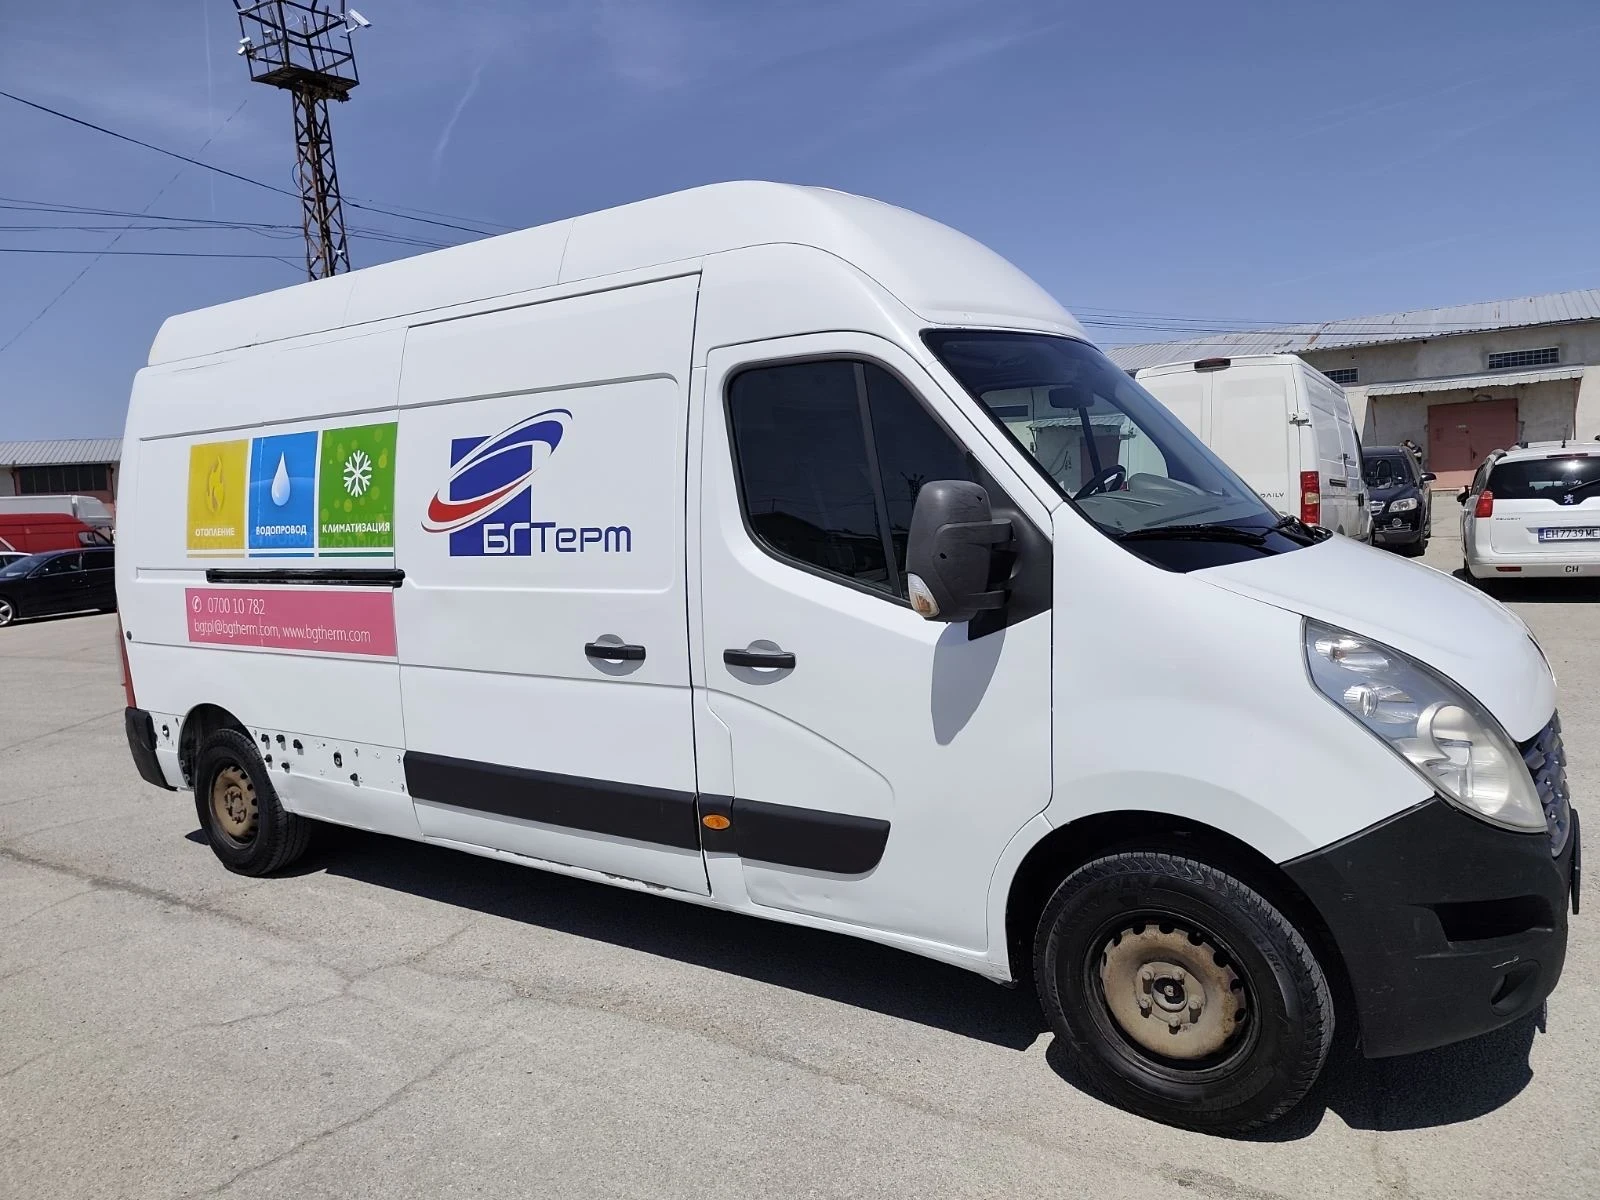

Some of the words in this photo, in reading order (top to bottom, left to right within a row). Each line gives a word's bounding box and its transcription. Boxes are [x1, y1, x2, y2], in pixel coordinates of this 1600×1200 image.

[195, 527, 235, 537] ОТОПЛЕНИЕ
[255, 524, 307, 536] ВОДОПРОВОД
[322, 522, 391, 534] КЛИМАТИЗАЦИЯ
[208, 597, 231, 614] 0700
[233, 598, 245, 615] 10
[247, 598, 265, 615] 782
[282, 623, 371, 643] www.bgtherm.com
